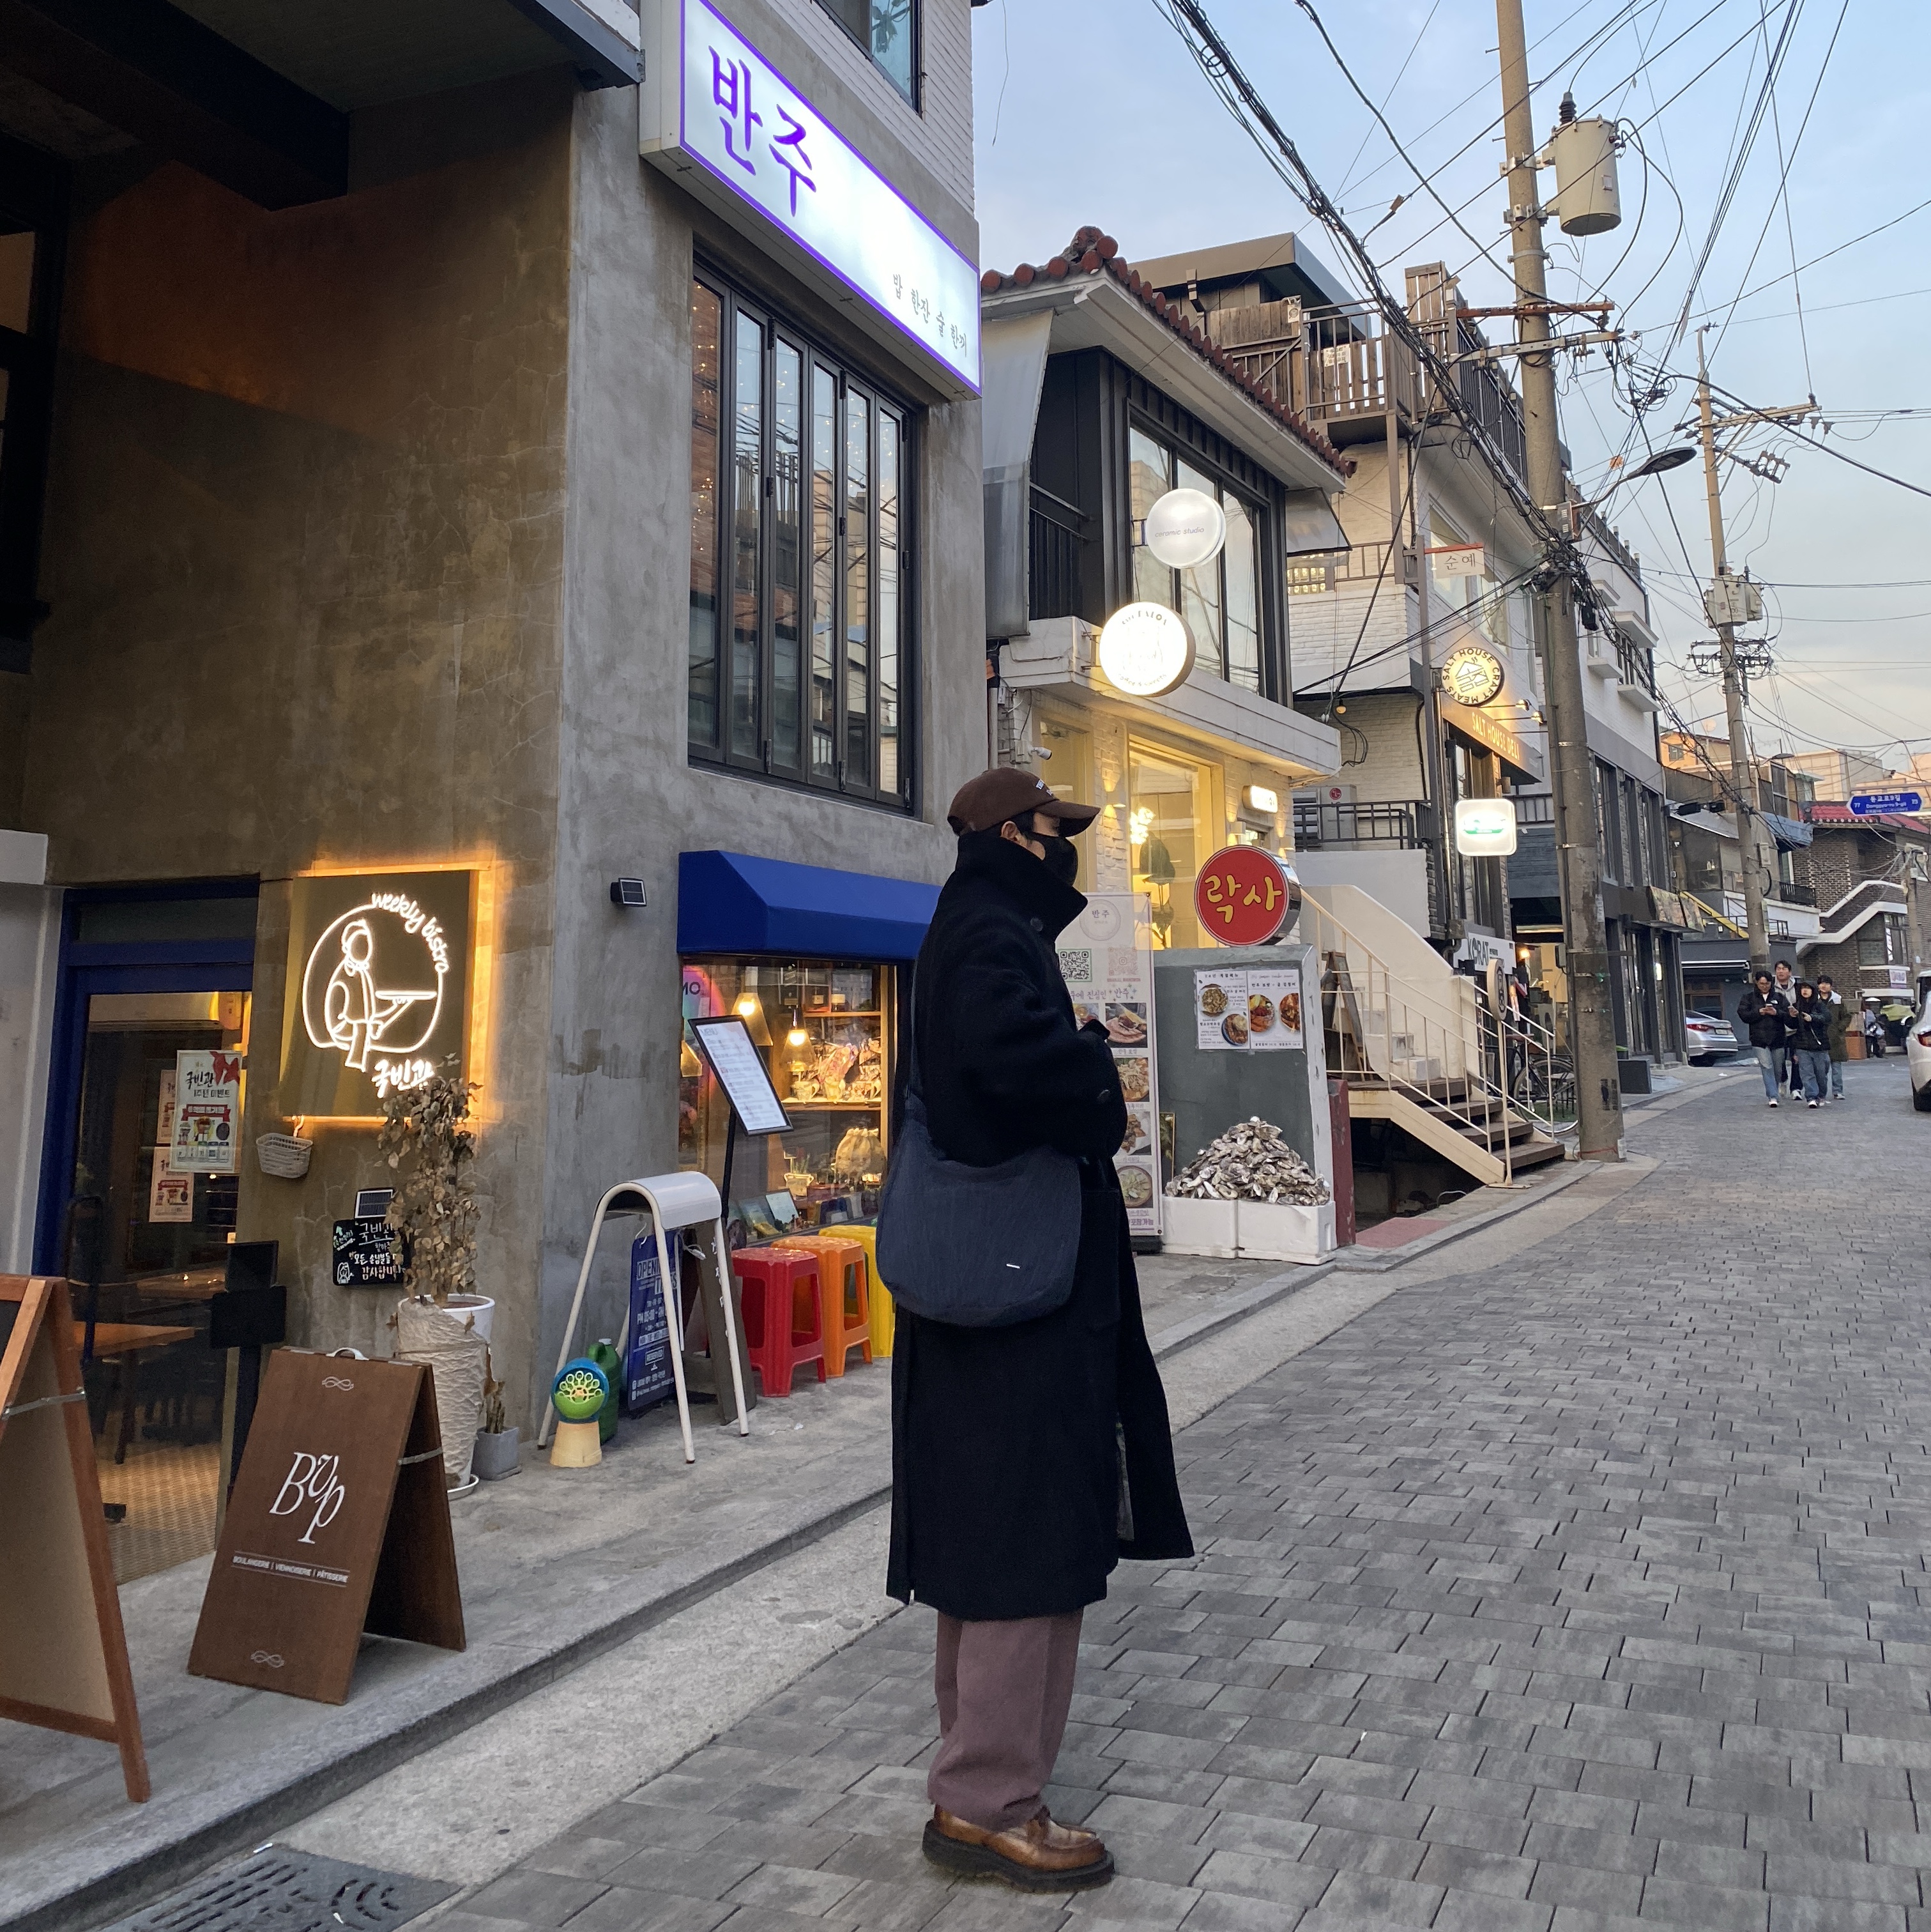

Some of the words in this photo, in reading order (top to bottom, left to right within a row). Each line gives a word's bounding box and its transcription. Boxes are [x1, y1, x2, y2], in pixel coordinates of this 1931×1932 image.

[708, 45, 817, 217] 반주
[893, 273, 903, 300] 밥
[911, 288, 931, 324] 한잔
[936, 312, 945, 337] 술
[950, 323, 968, 357] 한끼
[1155, 529, 1181, 537] ceramic
[1183, 526, 1205, 535] studio
[1458, 648, 1495, 664] HOUSE
[1442, 655, 1457, 681] SALT
[1482, 666, 1501, 700] CRAFT
[1446, 686, 1479, 703] MEATS
[1472, 711, 1486, 738] SALT
[1487, 722, 1507, 751] HOUSE
[1507, 736, 1520, 761] DELI
[1204, 875, 1283, 924] 락사
[1092, 909, 1110, 919] 반주
[371, 893, 427, 934] weekly
[421, 916, 450, 973] bistro
[1087, 990, 1106, 1000] 진심인
[1114, 987, 1129, 1000] 반주
[701, 1028, 718, 1036] MENU
[185, 1071, 215, 1090] 국빈관
[194, 1089, 210, 1098] 1주년
[211, 1089, 231, 1098] 이벤트
[369, 1252, 405, 1265] 손님분들
